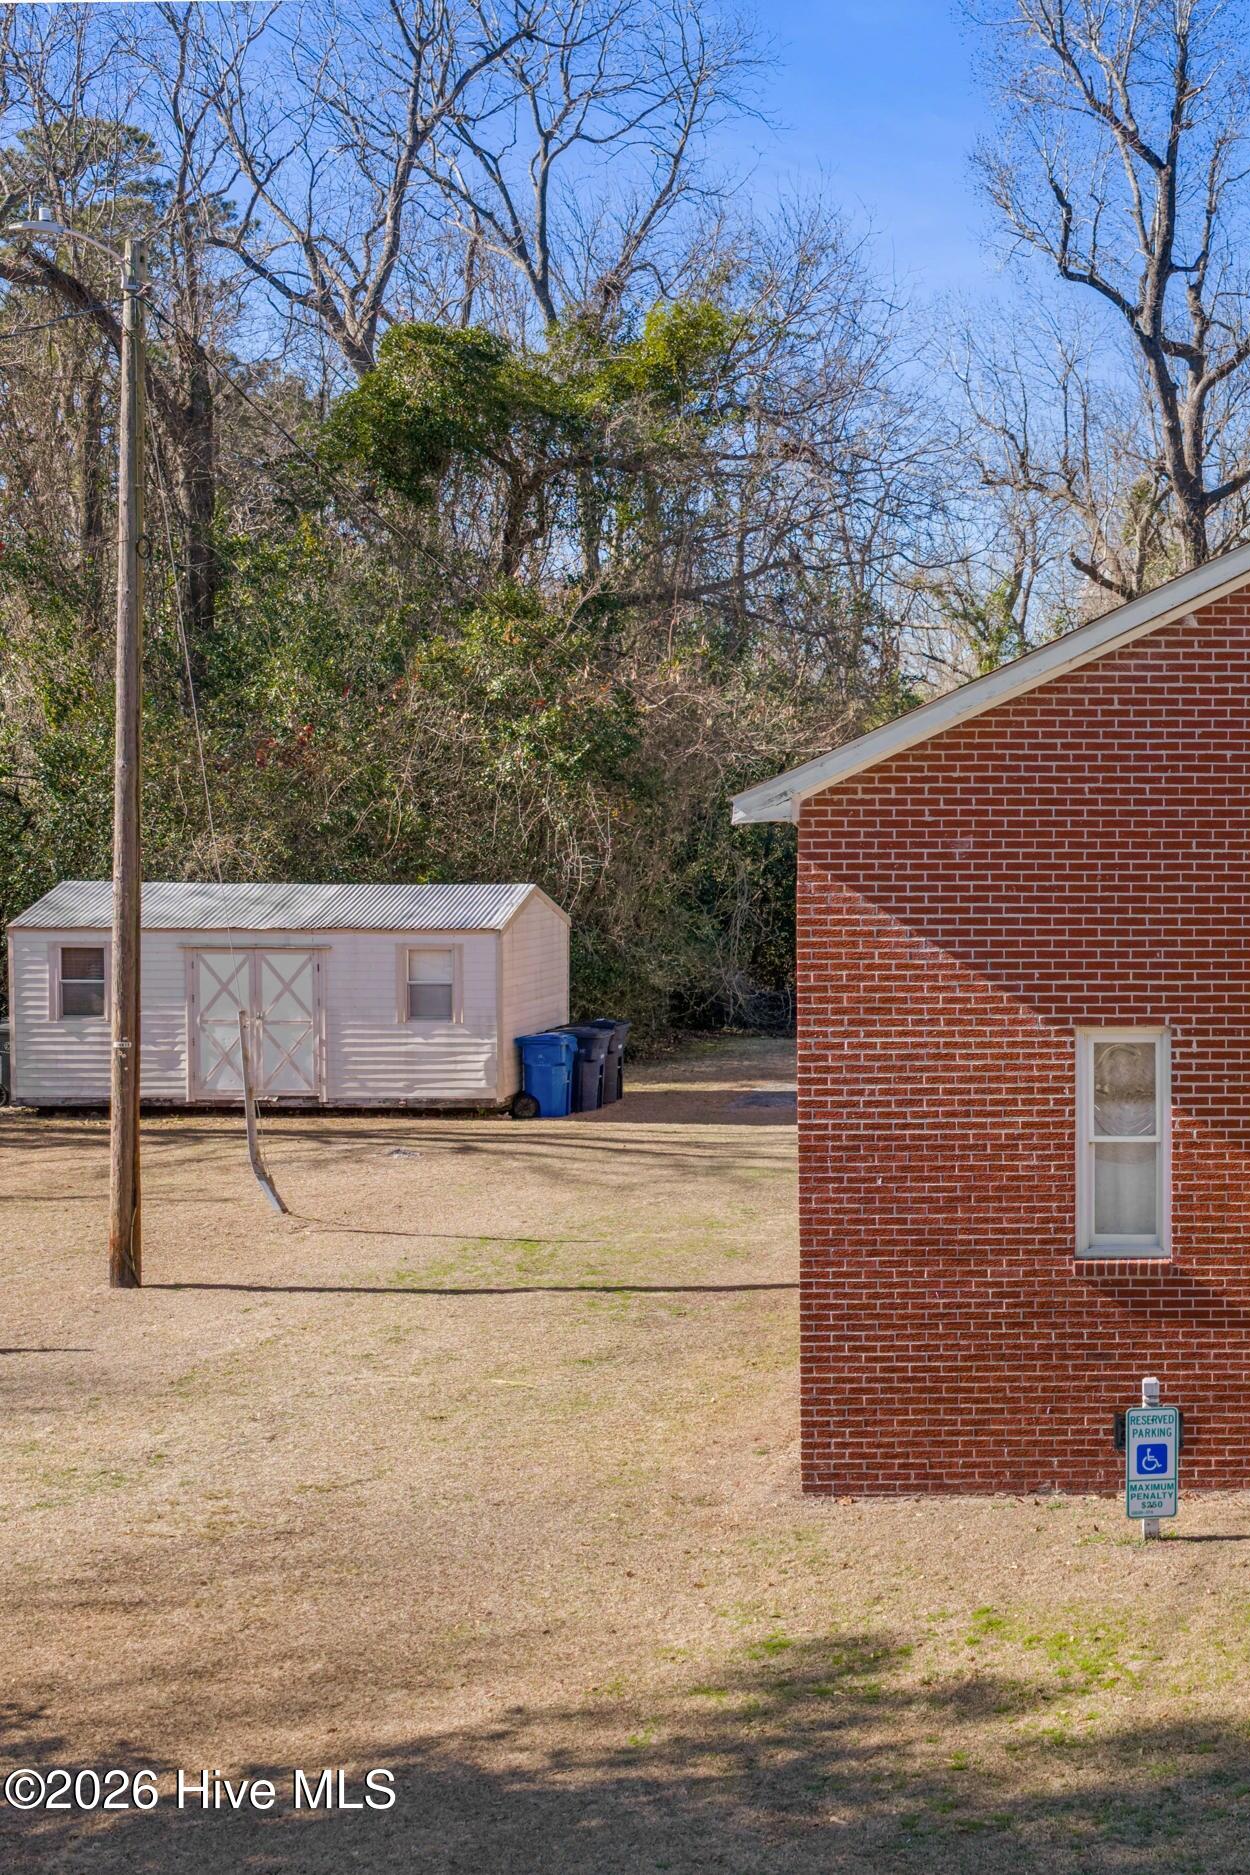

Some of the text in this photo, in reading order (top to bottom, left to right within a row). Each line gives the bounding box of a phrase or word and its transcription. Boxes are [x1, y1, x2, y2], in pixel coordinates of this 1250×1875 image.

[1130, 1415, 1174, 1425] RESERVED
[1132, 1428, 1172, 1438] PARKING
[1130, 1483, 1174, 1492] MAXIMUM
[1130, 1492, 1173, 1500] PENALTY
[1141, 1501, 1163, 1509] $250
